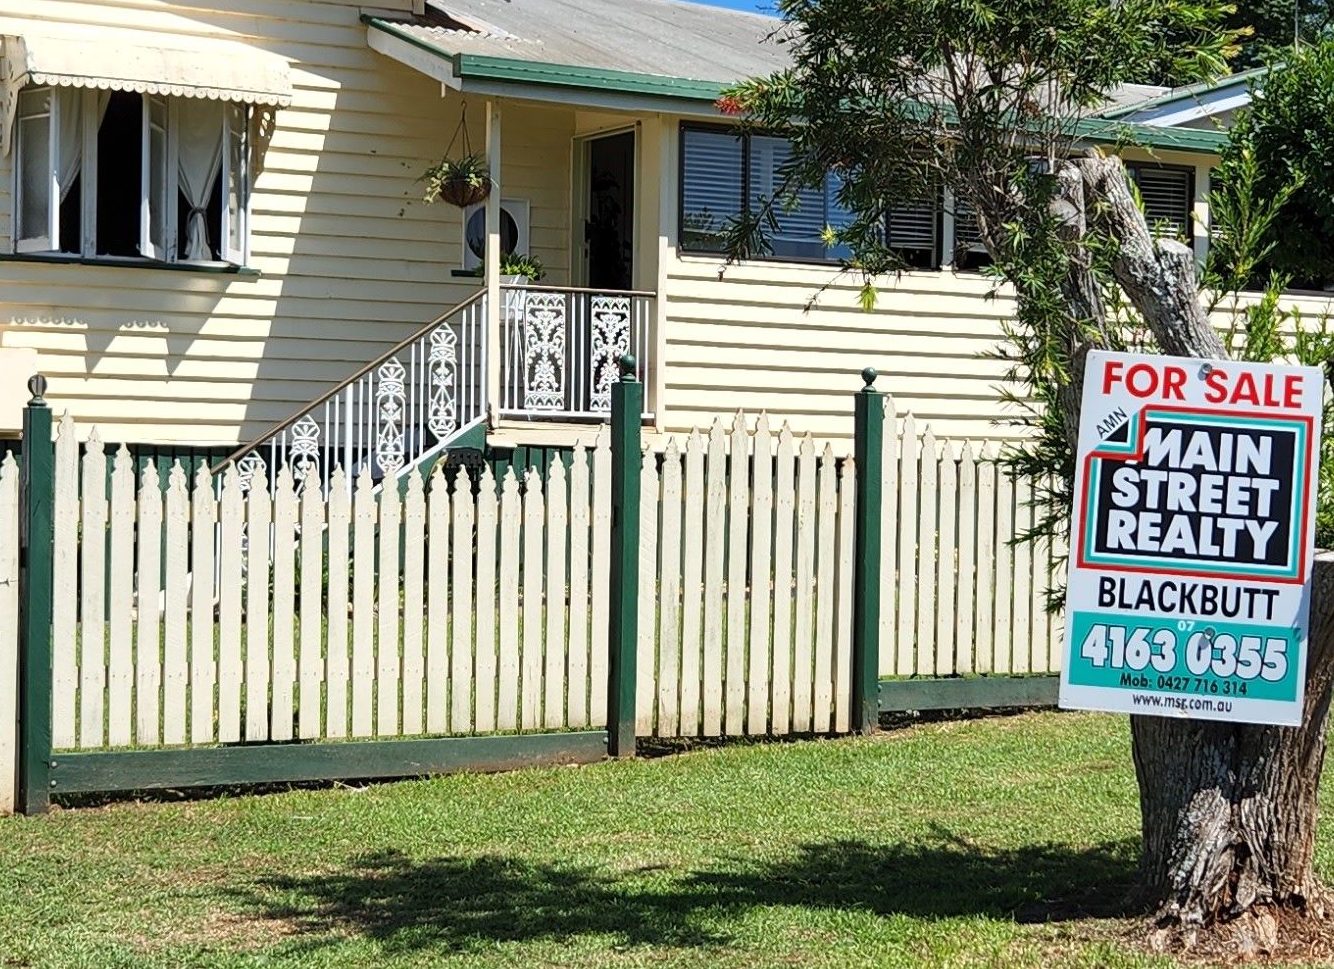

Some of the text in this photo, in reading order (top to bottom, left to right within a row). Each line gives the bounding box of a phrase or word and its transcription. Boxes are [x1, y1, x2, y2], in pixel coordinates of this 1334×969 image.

[1102, 361, 1304, 408] FOR SALE
[1096, 406, 1128, 438] AMN
[1124, 427, 1272, 475] MAIN
[1111, 467, 1280, 518] STREET
[1106, 509, 1279, 560] REALTY
[1098, 576, 1280, 621] BLACKBUTT
[1177, 620, 1195, 631] 07
[1080, 623, 1289, 682] 4163 0355
[1119, 673, 1248, 695] Mob: 0427 716 314
[1132, 693, 1233, 713] www.msr.com.au
